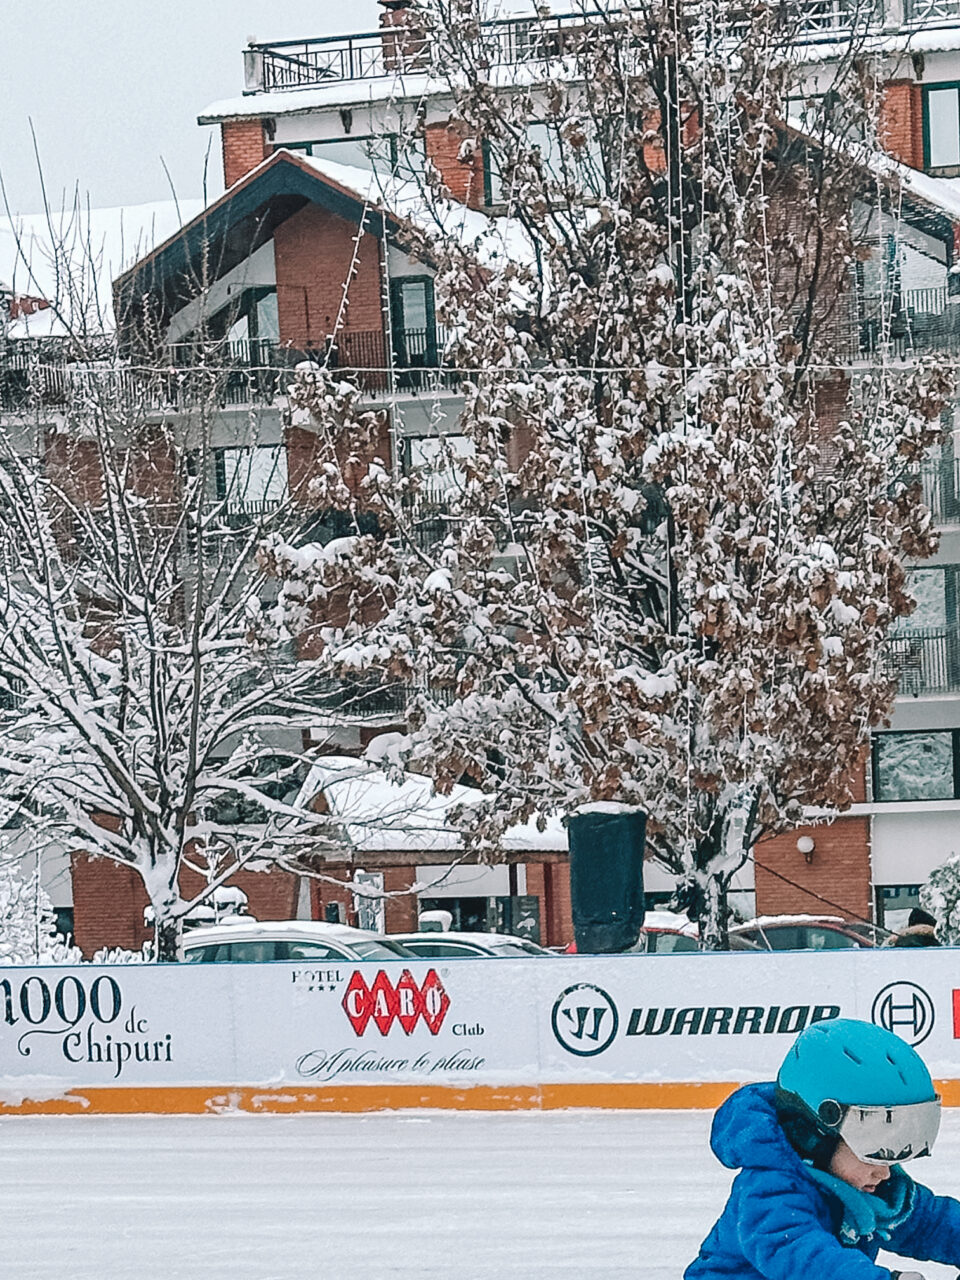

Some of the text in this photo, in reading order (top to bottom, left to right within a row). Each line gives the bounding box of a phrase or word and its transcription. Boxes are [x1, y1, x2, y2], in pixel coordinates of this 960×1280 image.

[124, 1004, 149, 1034] de
[346, 987, 444, 1019] CARO
[451, 1023, 485, 1037] Club
[62, 1022, 174, 1078] Chipuri
[295, 1048, 486, 1080] A pleasure to please
